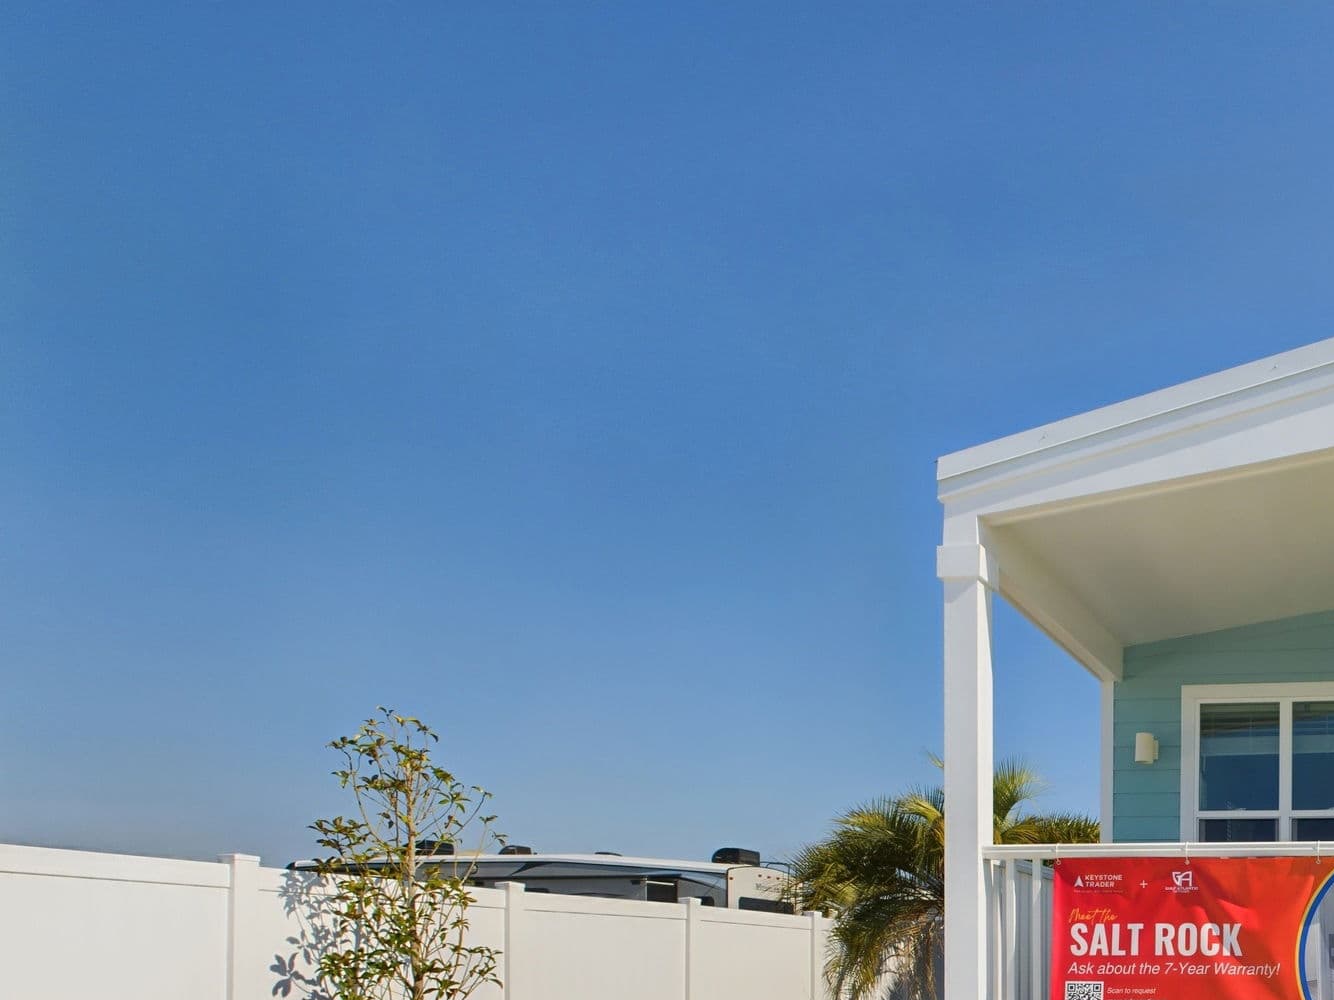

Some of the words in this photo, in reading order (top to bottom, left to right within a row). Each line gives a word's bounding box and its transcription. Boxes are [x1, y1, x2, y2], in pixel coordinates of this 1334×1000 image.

[1070, 923, 1144, 957] SALT
[1154, 923, 1243, 957] ROCK
[1068, 962, 1094, 975] Ask
[1097, 962, 1136, 975] about
[1137, 962, 1160, 975] the
[1164, 963, 1209, 975] 7-Year
[1214, 963, 1280, 978] Warranty!
[1132, 988, 1157, 996] request
